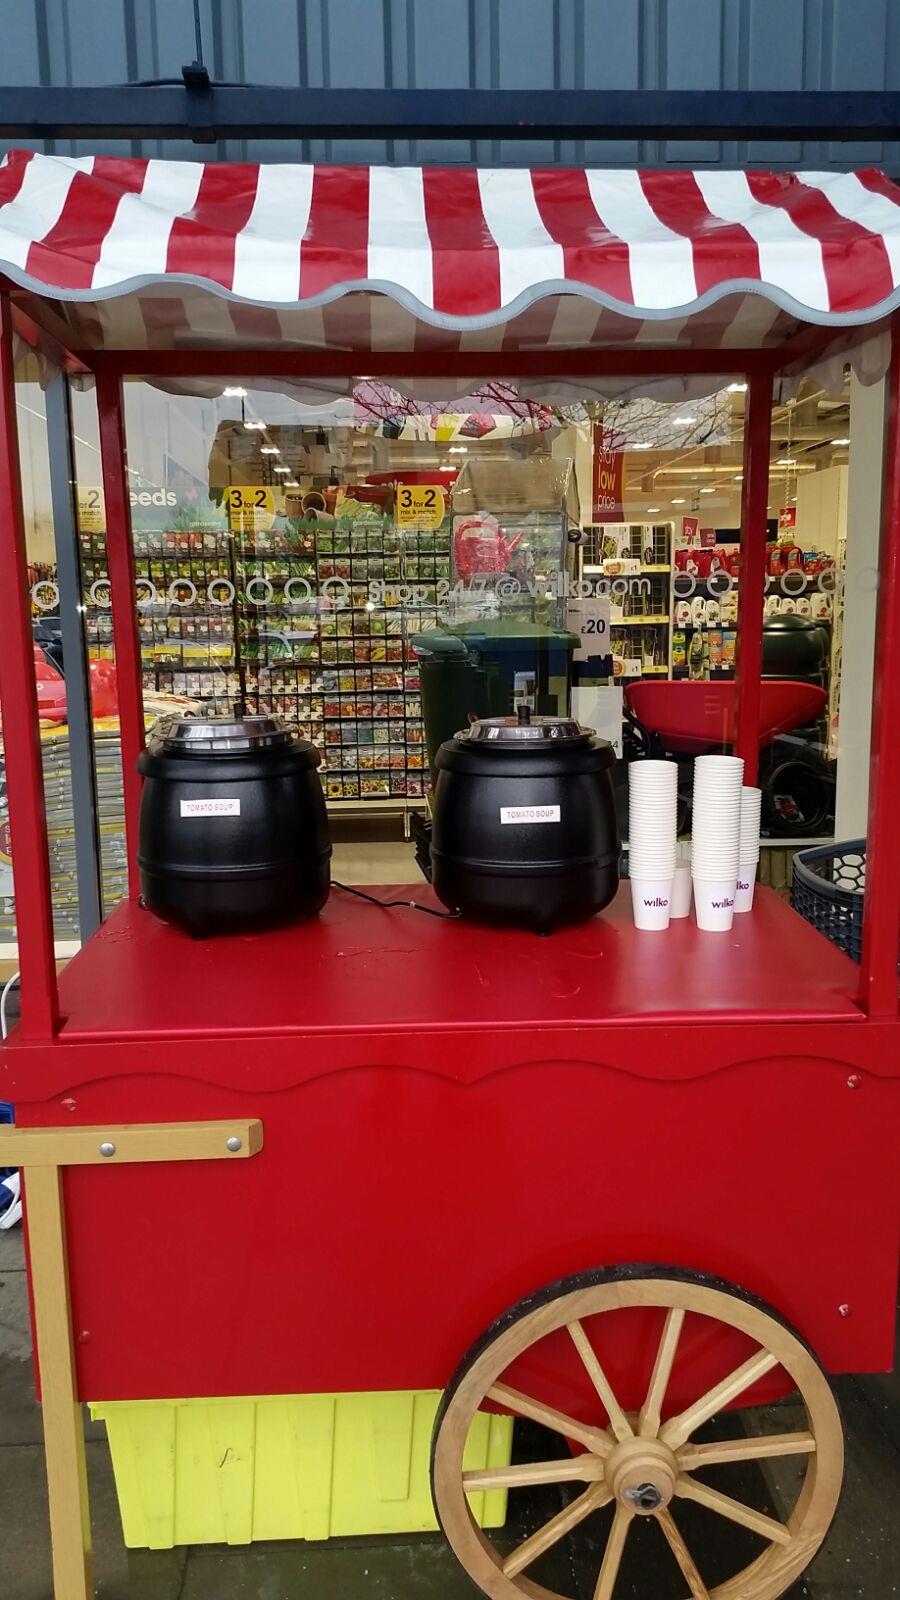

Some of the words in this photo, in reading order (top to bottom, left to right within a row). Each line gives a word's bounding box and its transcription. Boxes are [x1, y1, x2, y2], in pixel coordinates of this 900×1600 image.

[598, 463, 616, 491] low
[88, 489, 101, 509] 2
[130, 487, 178, 507] eeds
[230, 489, 243, 509] 3
[243, 500, 255, 509] for
[254, 489, 267, 509] 2
[400, 489, 413, 508] 3
[413, 500, 424, 508] for
[424, 489, 436, 508] 2
[597, 491, 616, 511] price
[495, 575, 522, 600] @
[526, 571, 652, 597] wilko.com
[581, 619, 606, 634] £20
[186, 803, 213, 812] TOMATO
[214, 803, 233, 811] SOUP
[506, 810, 535, 819] TOMATO
[535, 809, 555, 818] SOUP
[736, 880, 750, 890] lko
[644, 897, 669, 907] wilko
[711, 897, 735, 908] wilko
